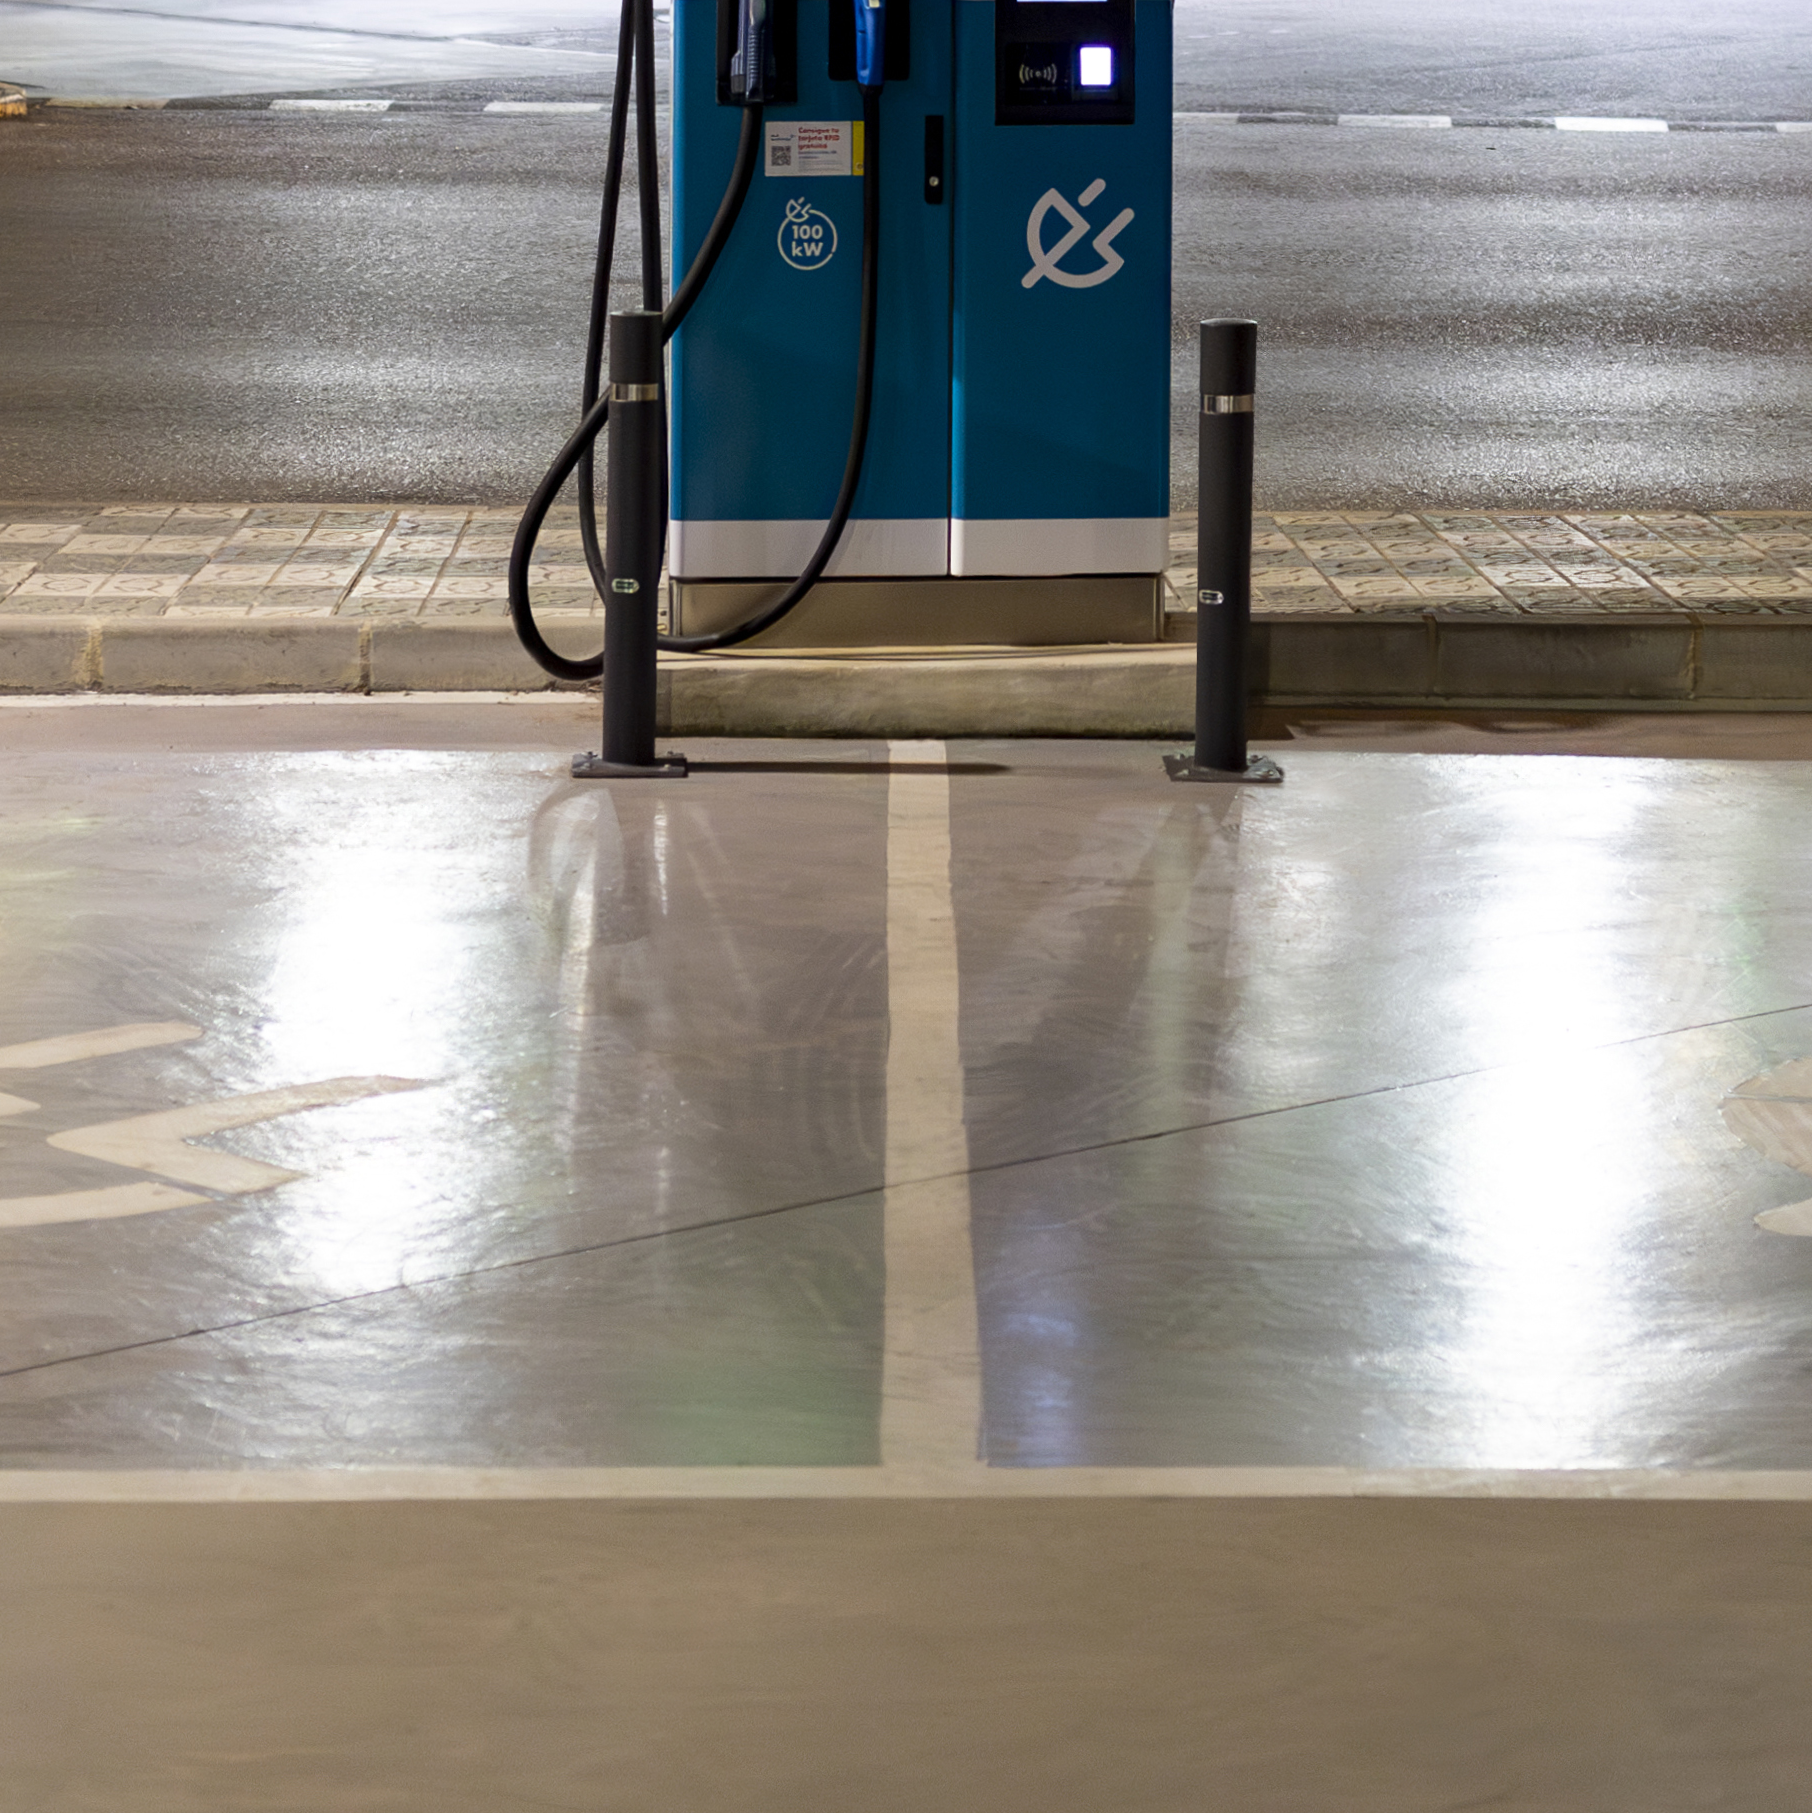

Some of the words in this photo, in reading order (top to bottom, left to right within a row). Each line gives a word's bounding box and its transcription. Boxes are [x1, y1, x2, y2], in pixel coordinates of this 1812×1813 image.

[798, 127, 830, 135] Consigue
[792, 225, 823, 240] 100
[792, 241, 823, 257] kW
